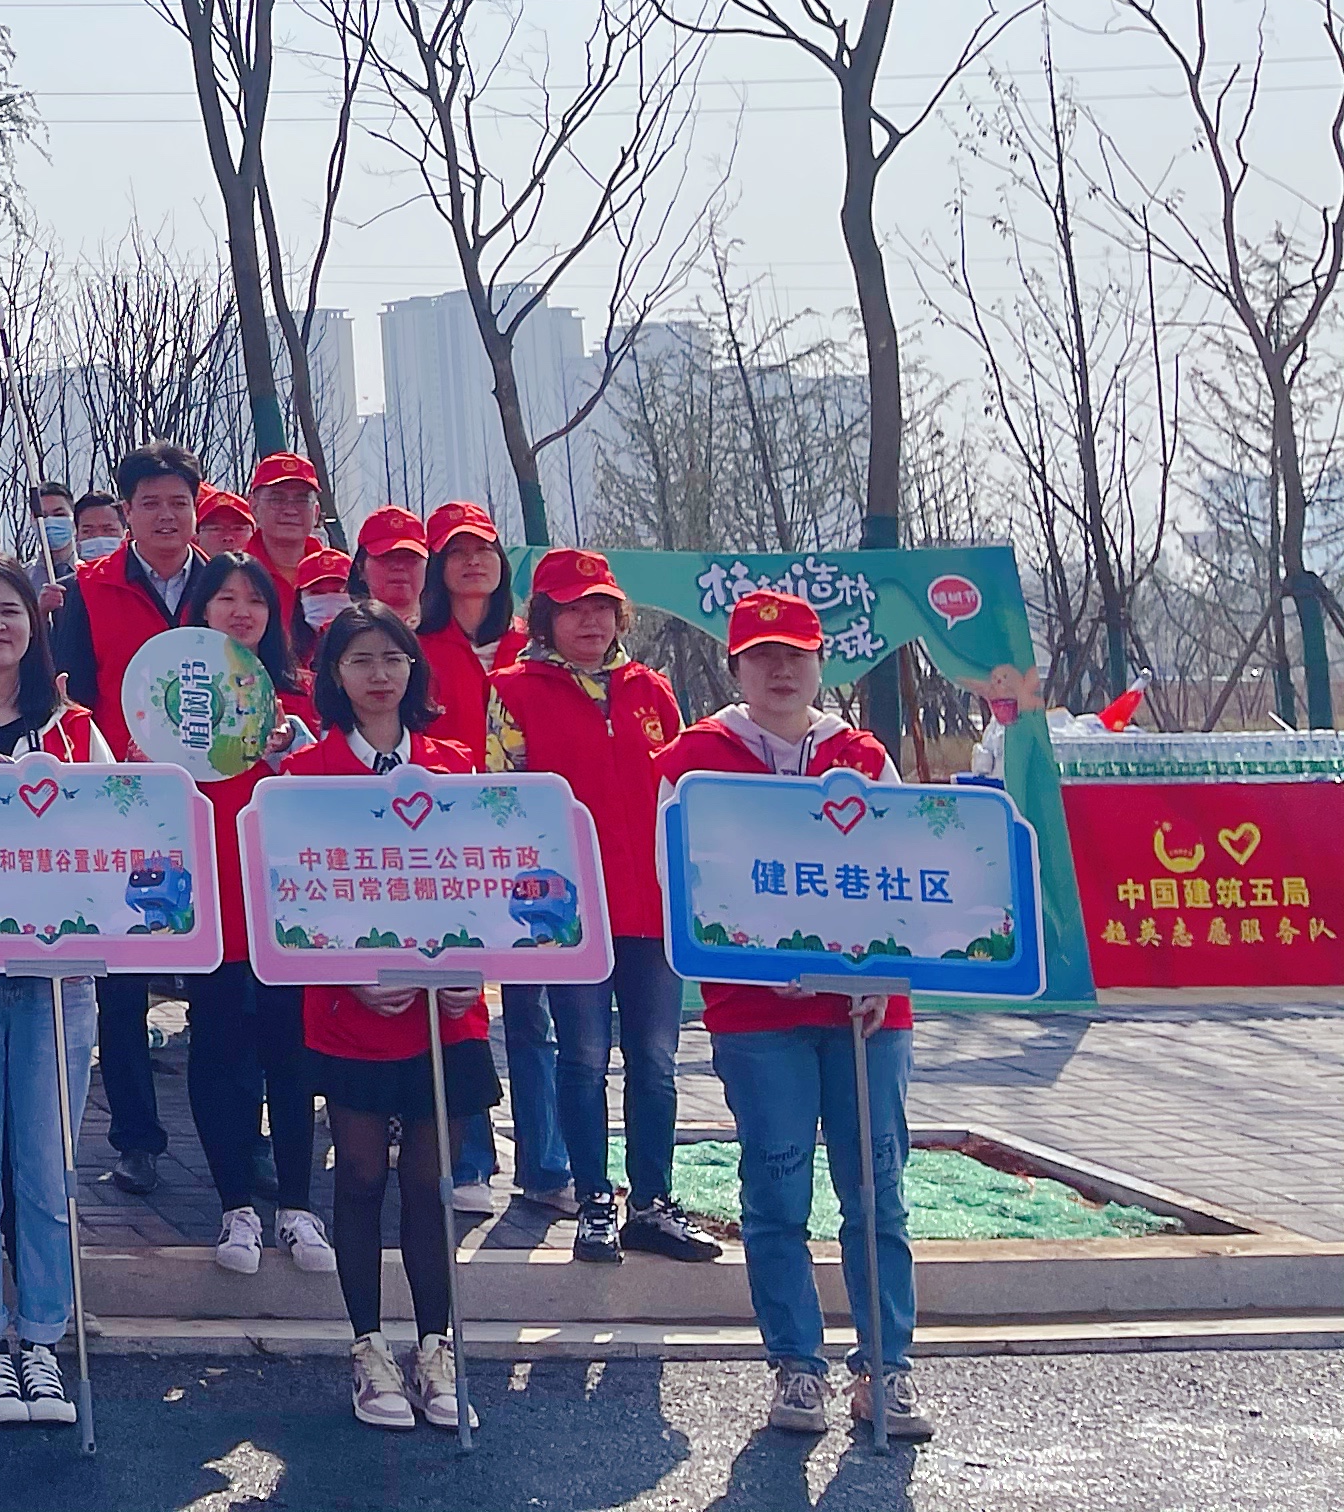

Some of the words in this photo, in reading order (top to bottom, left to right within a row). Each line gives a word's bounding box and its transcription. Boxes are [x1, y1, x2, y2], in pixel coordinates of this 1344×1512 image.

[179, 658, 210, 749] 植树节
[298, 846, 540, 871] 中建五局三公司市政
[751, 858, 954, 904] 健民巷社区
[1117, 876, 1310, 910] 中国建筑五局
[1100, 916, 1338, 948] 超英志愿服务队
